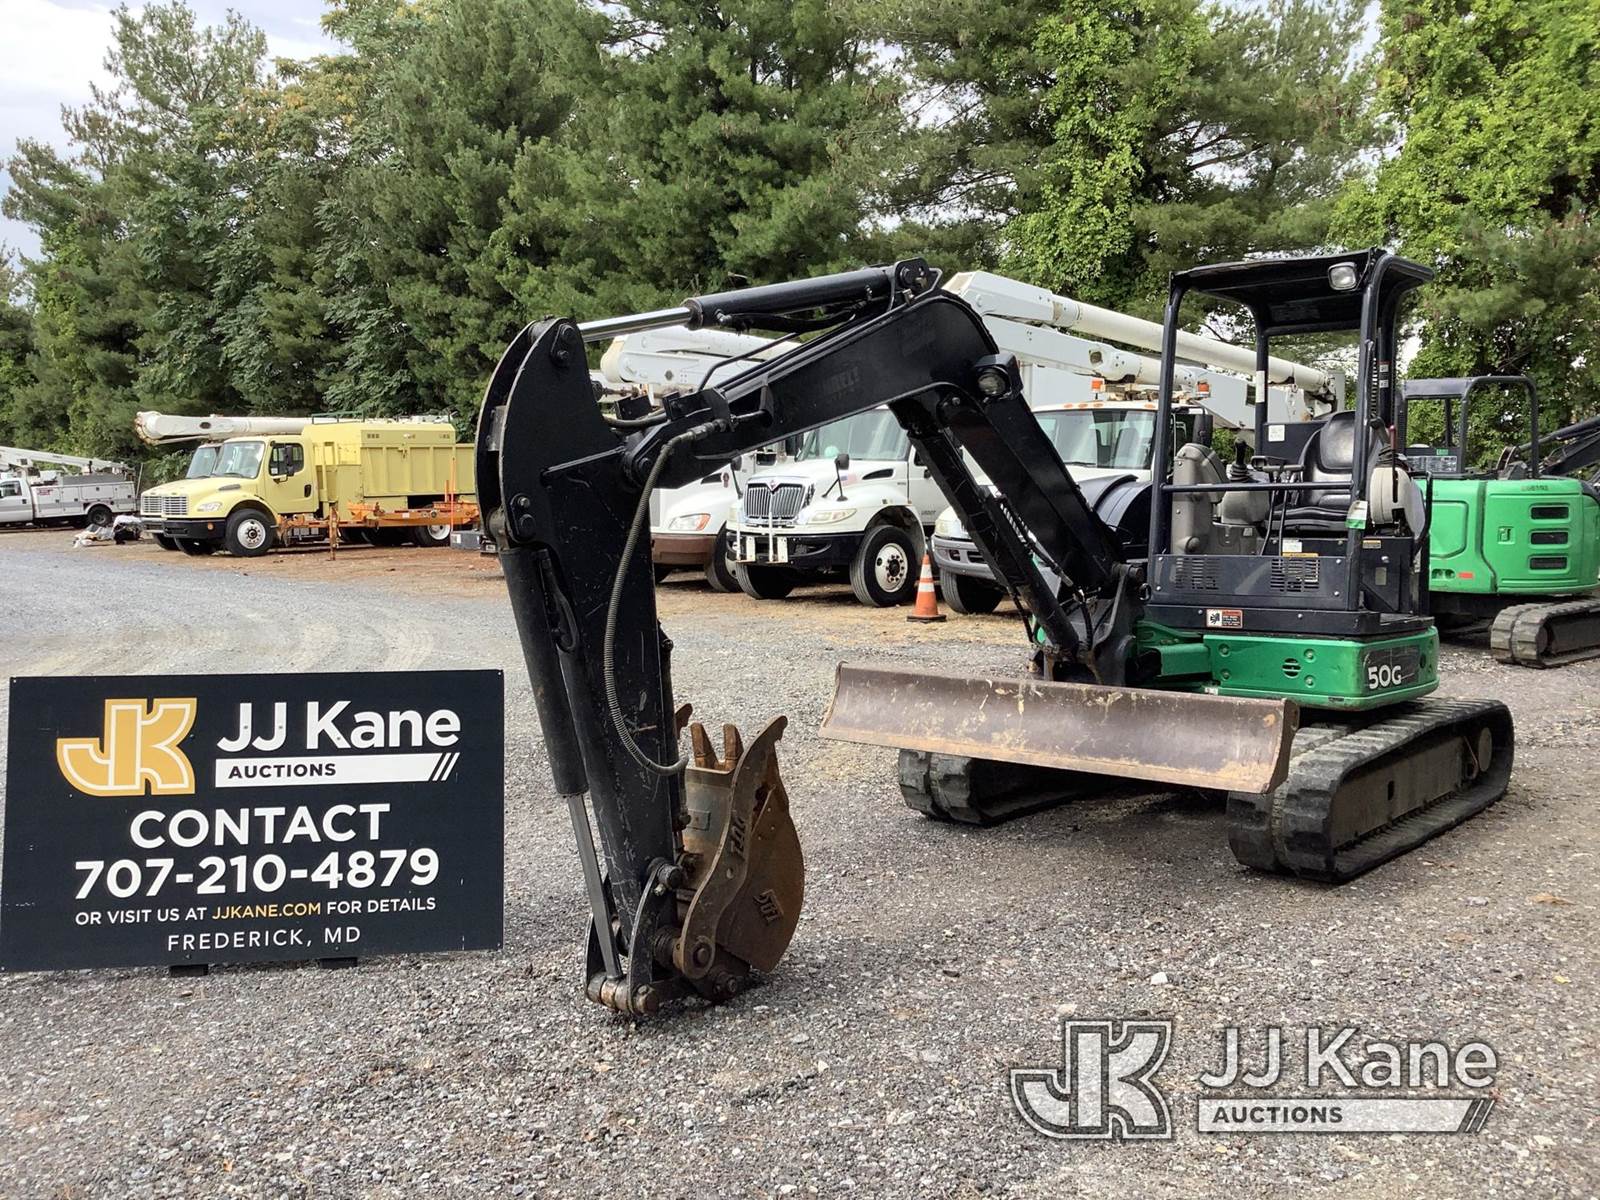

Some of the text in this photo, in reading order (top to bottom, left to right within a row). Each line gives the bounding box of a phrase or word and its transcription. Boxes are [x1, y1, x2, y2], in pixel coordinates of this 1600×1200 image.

[1367, 664, 1402, 690] 50G
[216, 700, 461, 753] JJ Kane
[228, 762, 337, 780] AUCTIONS
[130, 803, 391, 849] CONTACT
[75, 848, 440, 900] 707-210-4879
[76, 897, 436, 926] OR VISIT US AT JJKANE.COM FOR DETAILS
[168, 926, 361, 951] FREDERICK, MD
